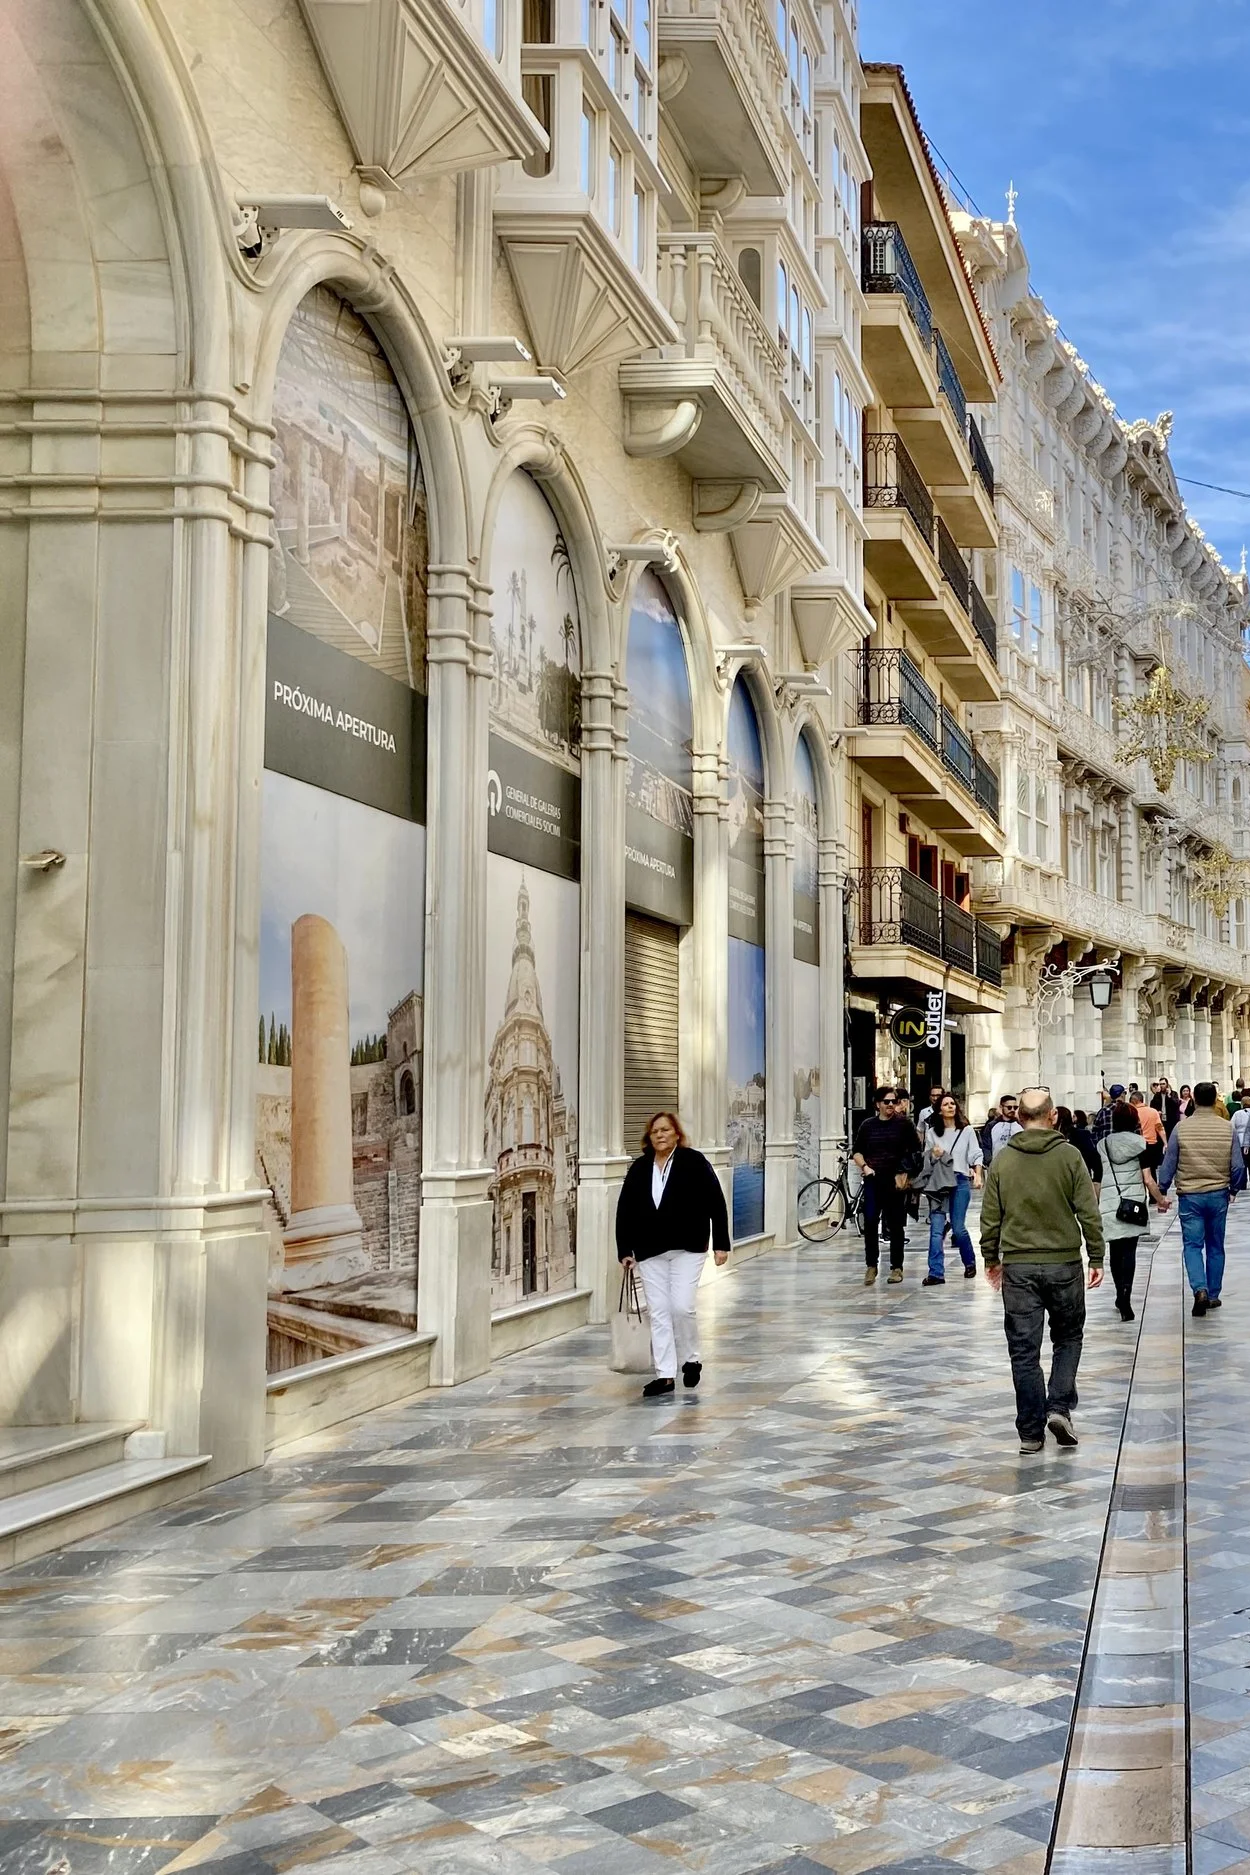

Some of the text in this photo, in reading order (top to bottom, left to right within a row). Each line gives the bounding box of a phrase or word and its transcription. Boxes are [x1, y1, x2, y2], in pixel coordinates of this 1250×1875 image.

[274, 680, 396, 753] PRÓXIMA APERTURA
[505, 786, 530, 807] GENERAL
[530, 796, 537, 810] DE
[925, 991, 943, 1048] outlet
